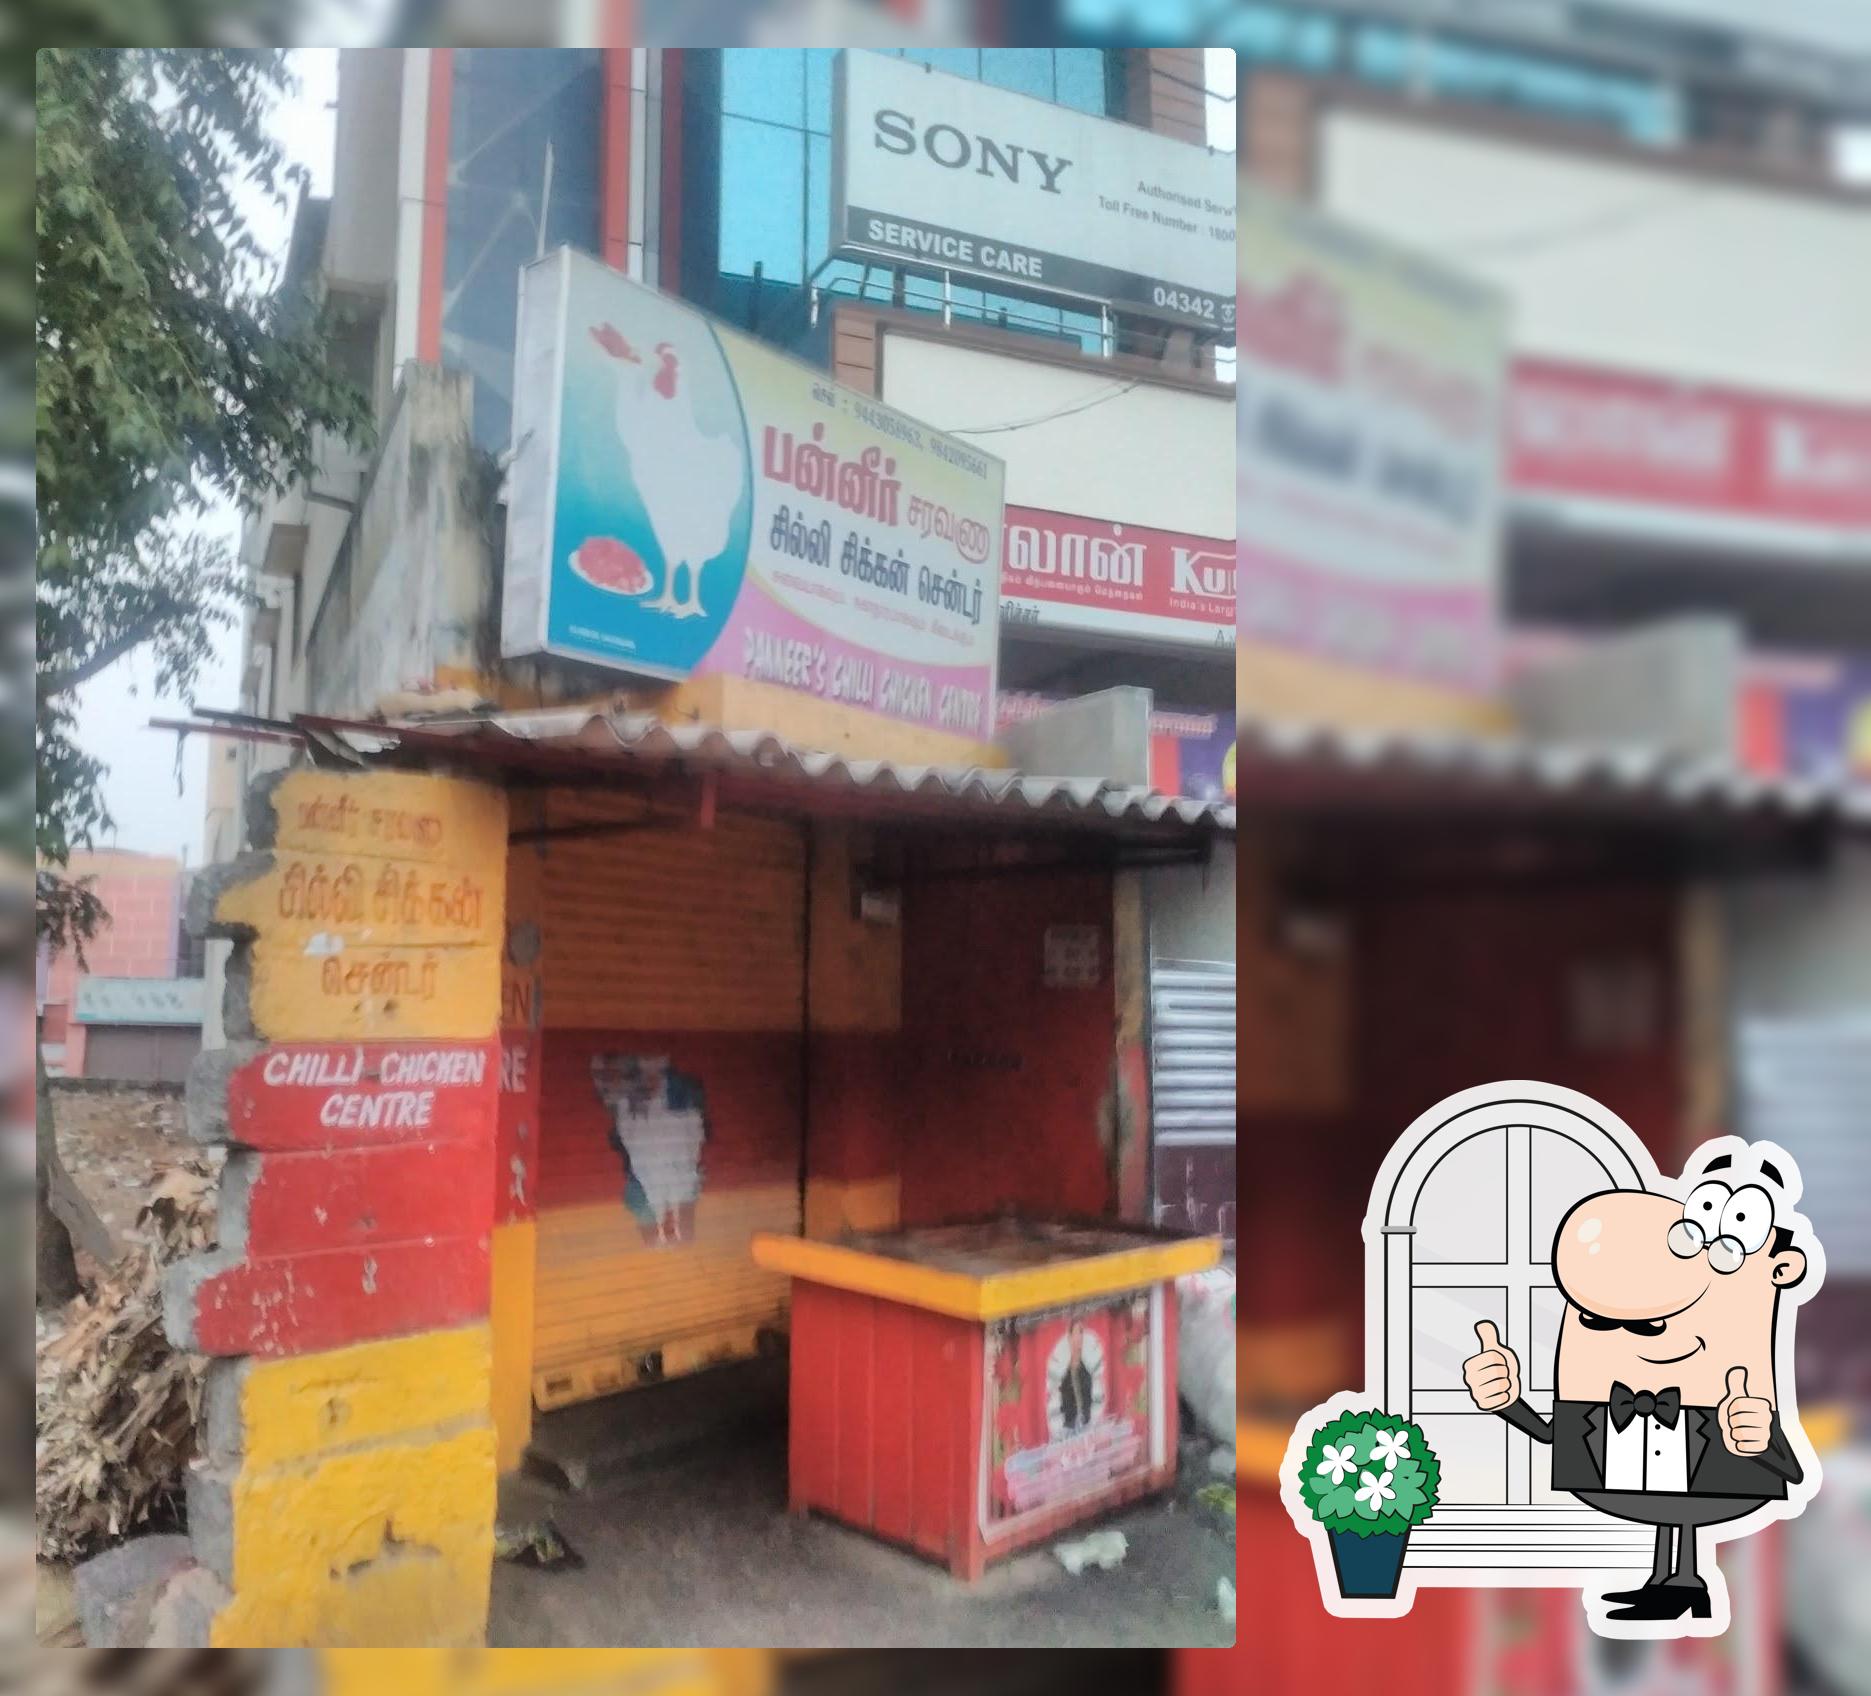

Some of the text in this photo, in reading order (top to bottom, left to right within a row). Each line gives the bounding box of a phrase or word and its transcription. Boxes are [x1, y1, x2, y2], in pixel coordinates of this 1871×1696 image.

[873, 108, 1073, 194] SONY
[1099, 195, 1120, 213] Toll
[1122, 202, 1149, 220] Free
[1152, 211, 1197, 233] Number
[1137, 180, 1201, 208] Authorised
[868, 219, 1043, 279] SERVICE CARE
[1153, 286, 1215, 320] 04342
[763, 421, 902, 527] பன்னீர்
[770, 504, 831, 569] சில்லி
[840, 531, 911, 596] சிக்கன்
[1003, 523, 1147, 586] லான்
[1169, 597, 1236, 618] India's Larg
[263, 1045, 487, 1087] CHILLI CHICKEN
[319, 1090, 435, 1128] CENTRE
